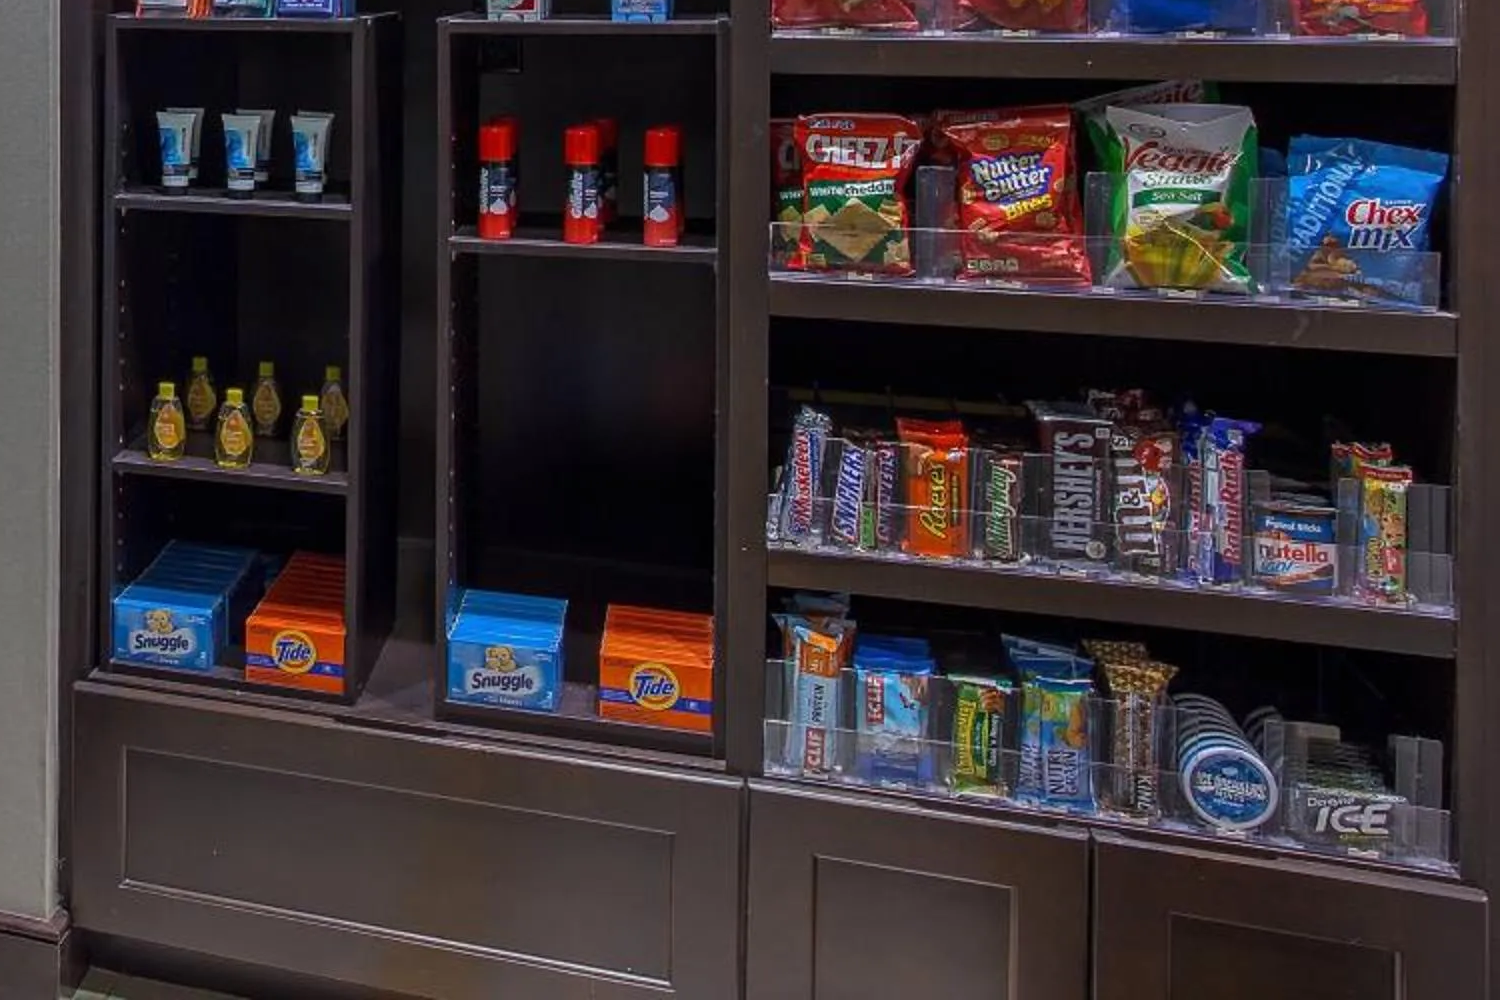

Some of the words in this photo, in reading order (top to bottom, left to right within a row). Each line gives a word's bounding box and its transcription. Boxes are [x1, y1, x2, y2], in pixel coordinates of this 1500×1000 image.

[971, 152, 1040, 182] Nutter
[845, 180, 895, 196] chedda
[983, 166, 1051, 201] Butter
[1005, 194, 1053, 220] Bites
[1346, 199, 1424, 227] Chex
[1348, 225, 1417, 251] mix
[833, 447, 866, 538] SNICKERS
[1053, 431, 1095, 550] HERSHEY'S
[1259, 545, 1329, 563] nutella
[134, 635, 190, 651] Snuggle
[276, 640, 311, 663] Tide
[471, 672, 534, 692] Snuggle
[633, 674, 675, 698] Tide
[807, 729, 823, 767] CLIF
[1315, 803, 1392, 834] ICE
